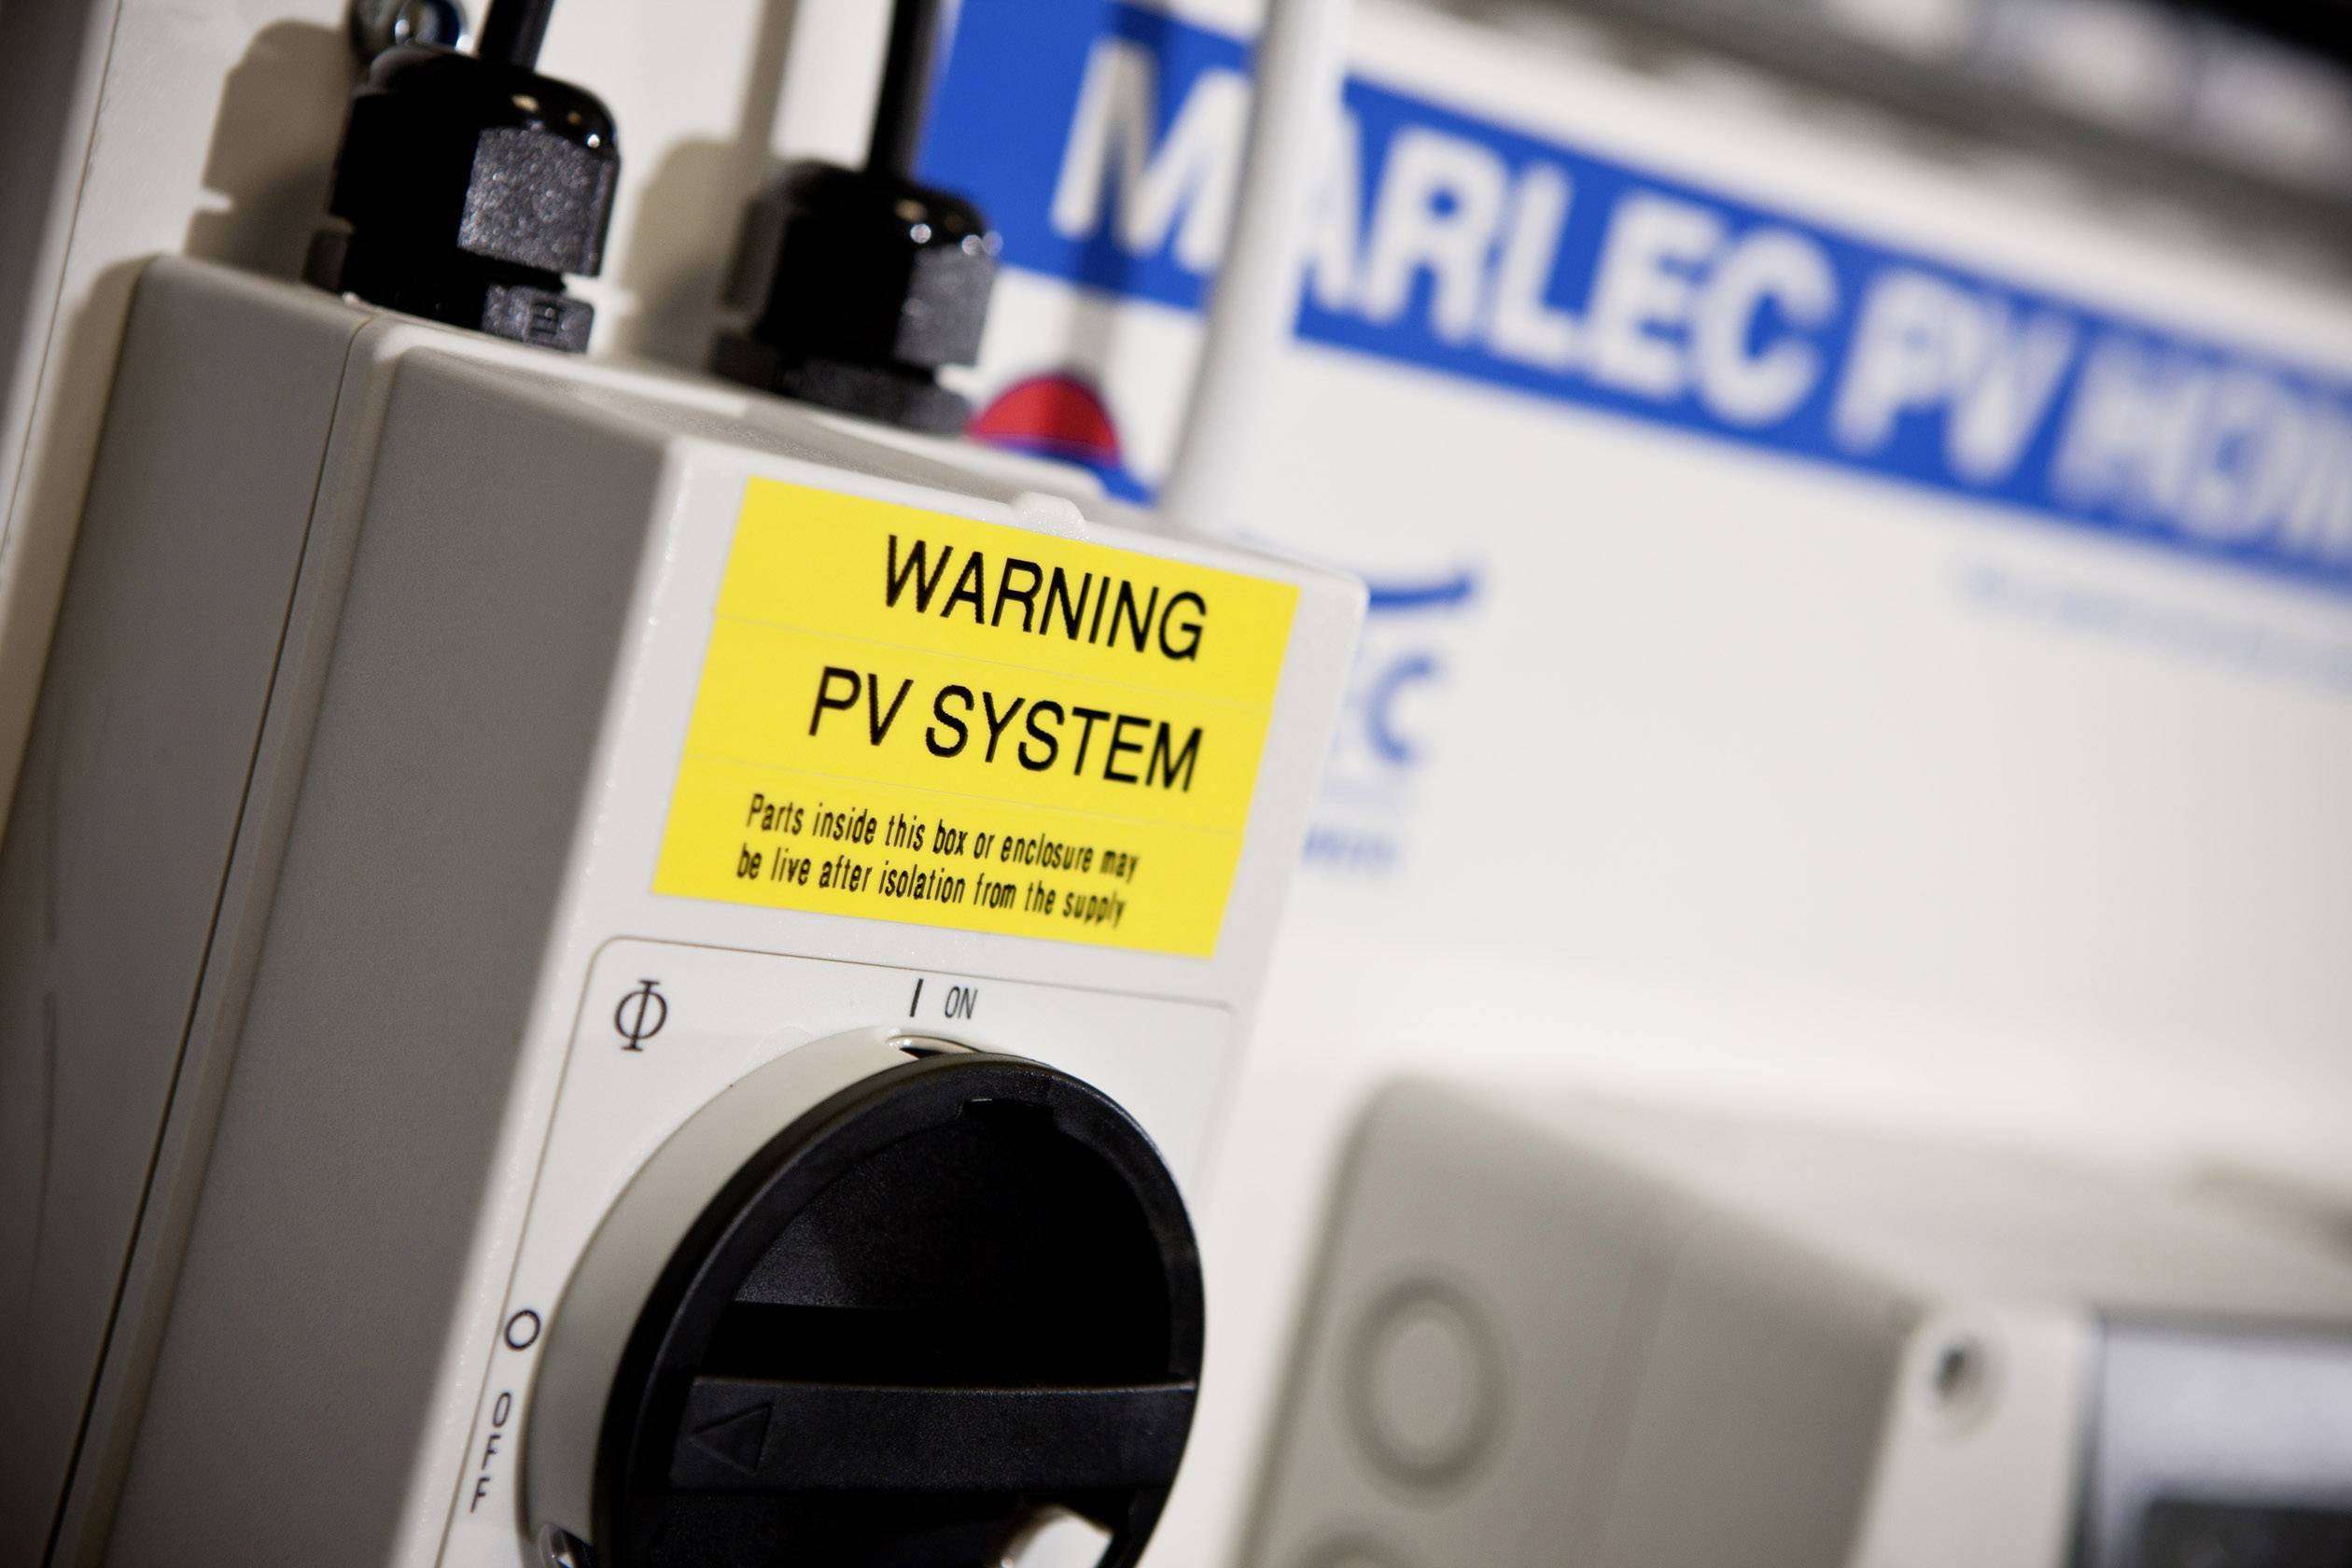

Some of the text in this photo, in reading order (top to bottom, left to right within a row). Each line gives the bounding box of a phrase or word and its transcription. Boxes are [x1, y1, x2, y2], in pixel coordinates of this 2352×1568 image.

[1831, 266, 2078, 485] PV
[885, 534, 1207, 663] WARNING
[808, 665, 1204, 791] PV SYSTEM
[736, 842, 1127, 930] be live after isolation from the supply
[746, 792, 1141, 885] Parts inside this box or enclosure may
[944, 986, 978, 1021] ON
[470, 1392, 512, 1514] OFF
